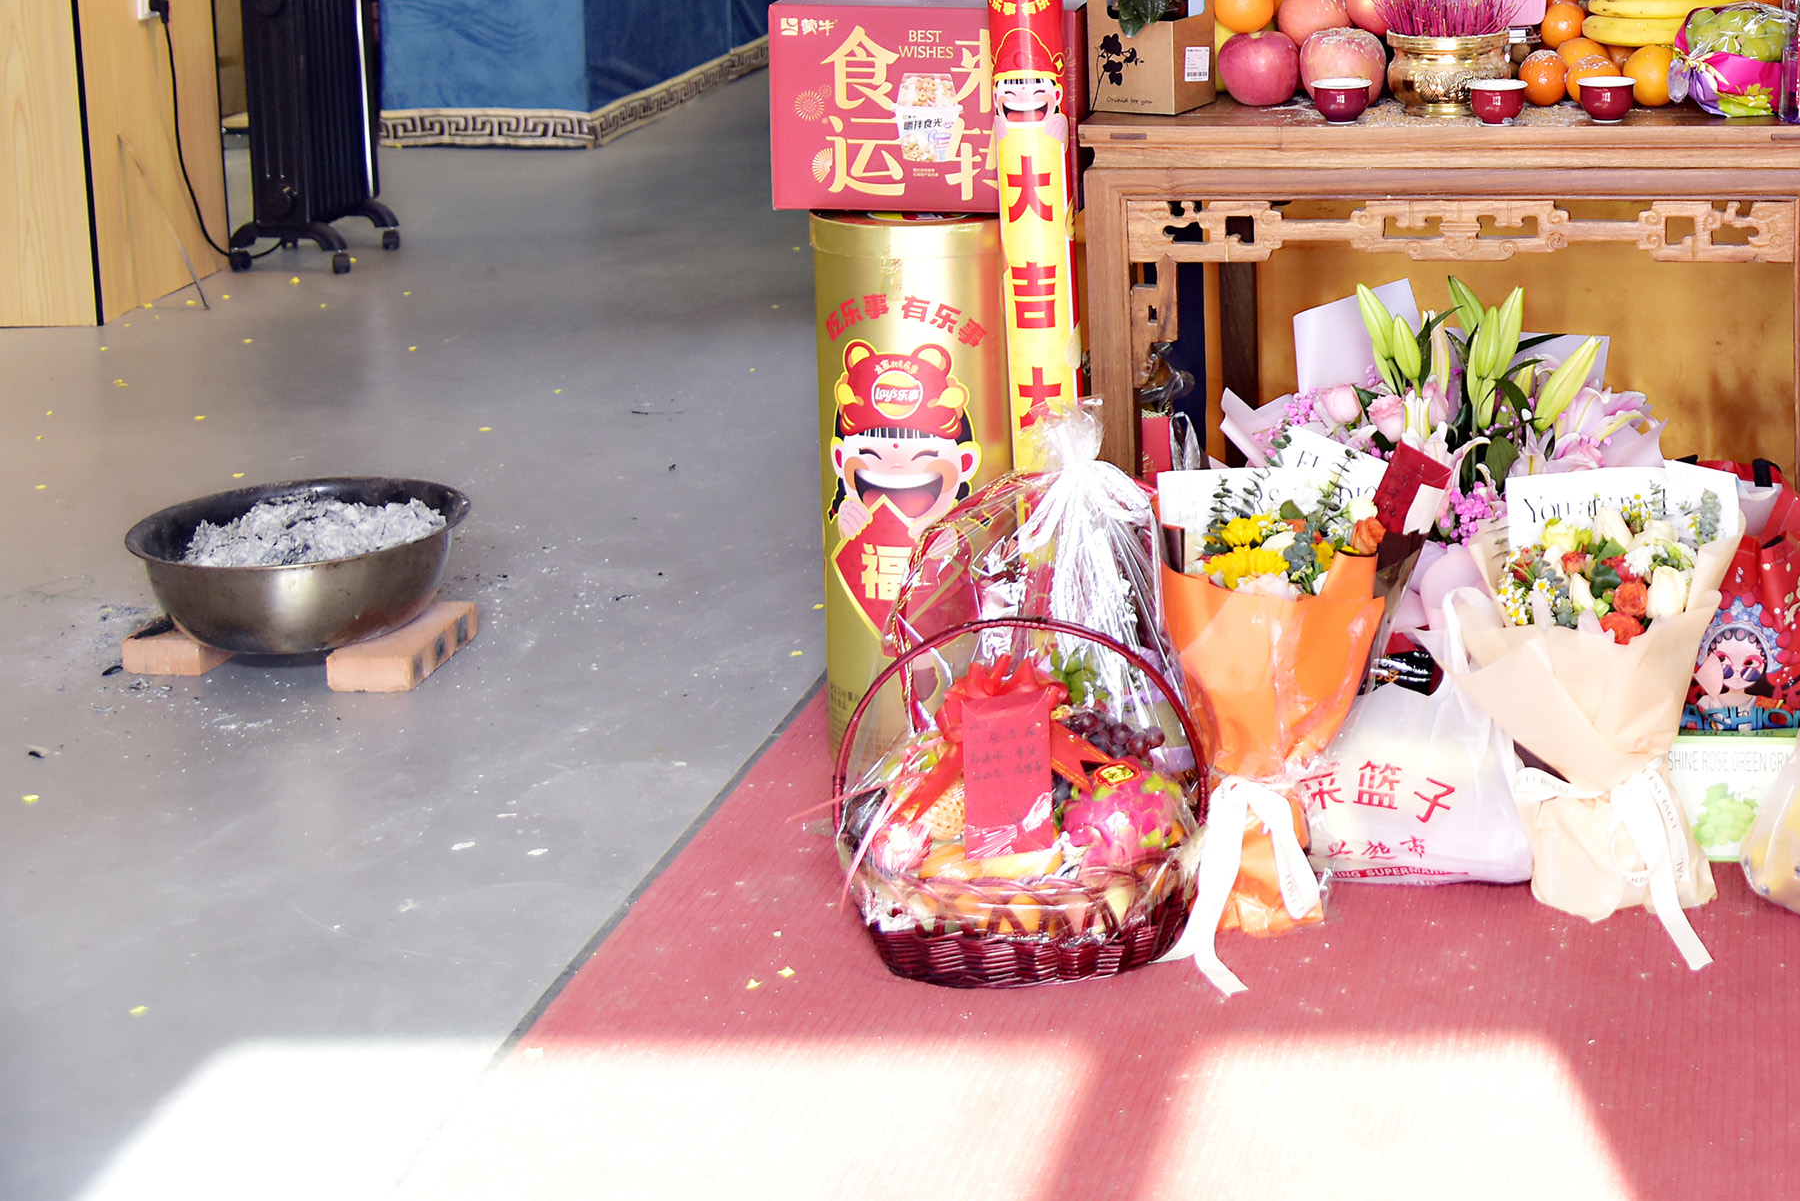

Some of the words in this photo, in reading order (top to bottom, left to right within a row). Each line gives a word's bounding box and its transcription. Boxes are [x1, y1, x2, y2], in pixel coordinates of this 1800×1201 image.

[801, 17, 836, 37] 蒙牛
[908, 29, 943, 43] BEST
[898, 45, 955, 60] WISHES
[825, 293, 890, 343] 吃乐事
[900, 295, 988, 348] 有乐事
[1523, 496, 1571, 523] You
[1667, 750, 1699, 772] SHINE
[1702, 750, 1729, 772] ROSE
[1731, 751, 1768, 773] GREEN
